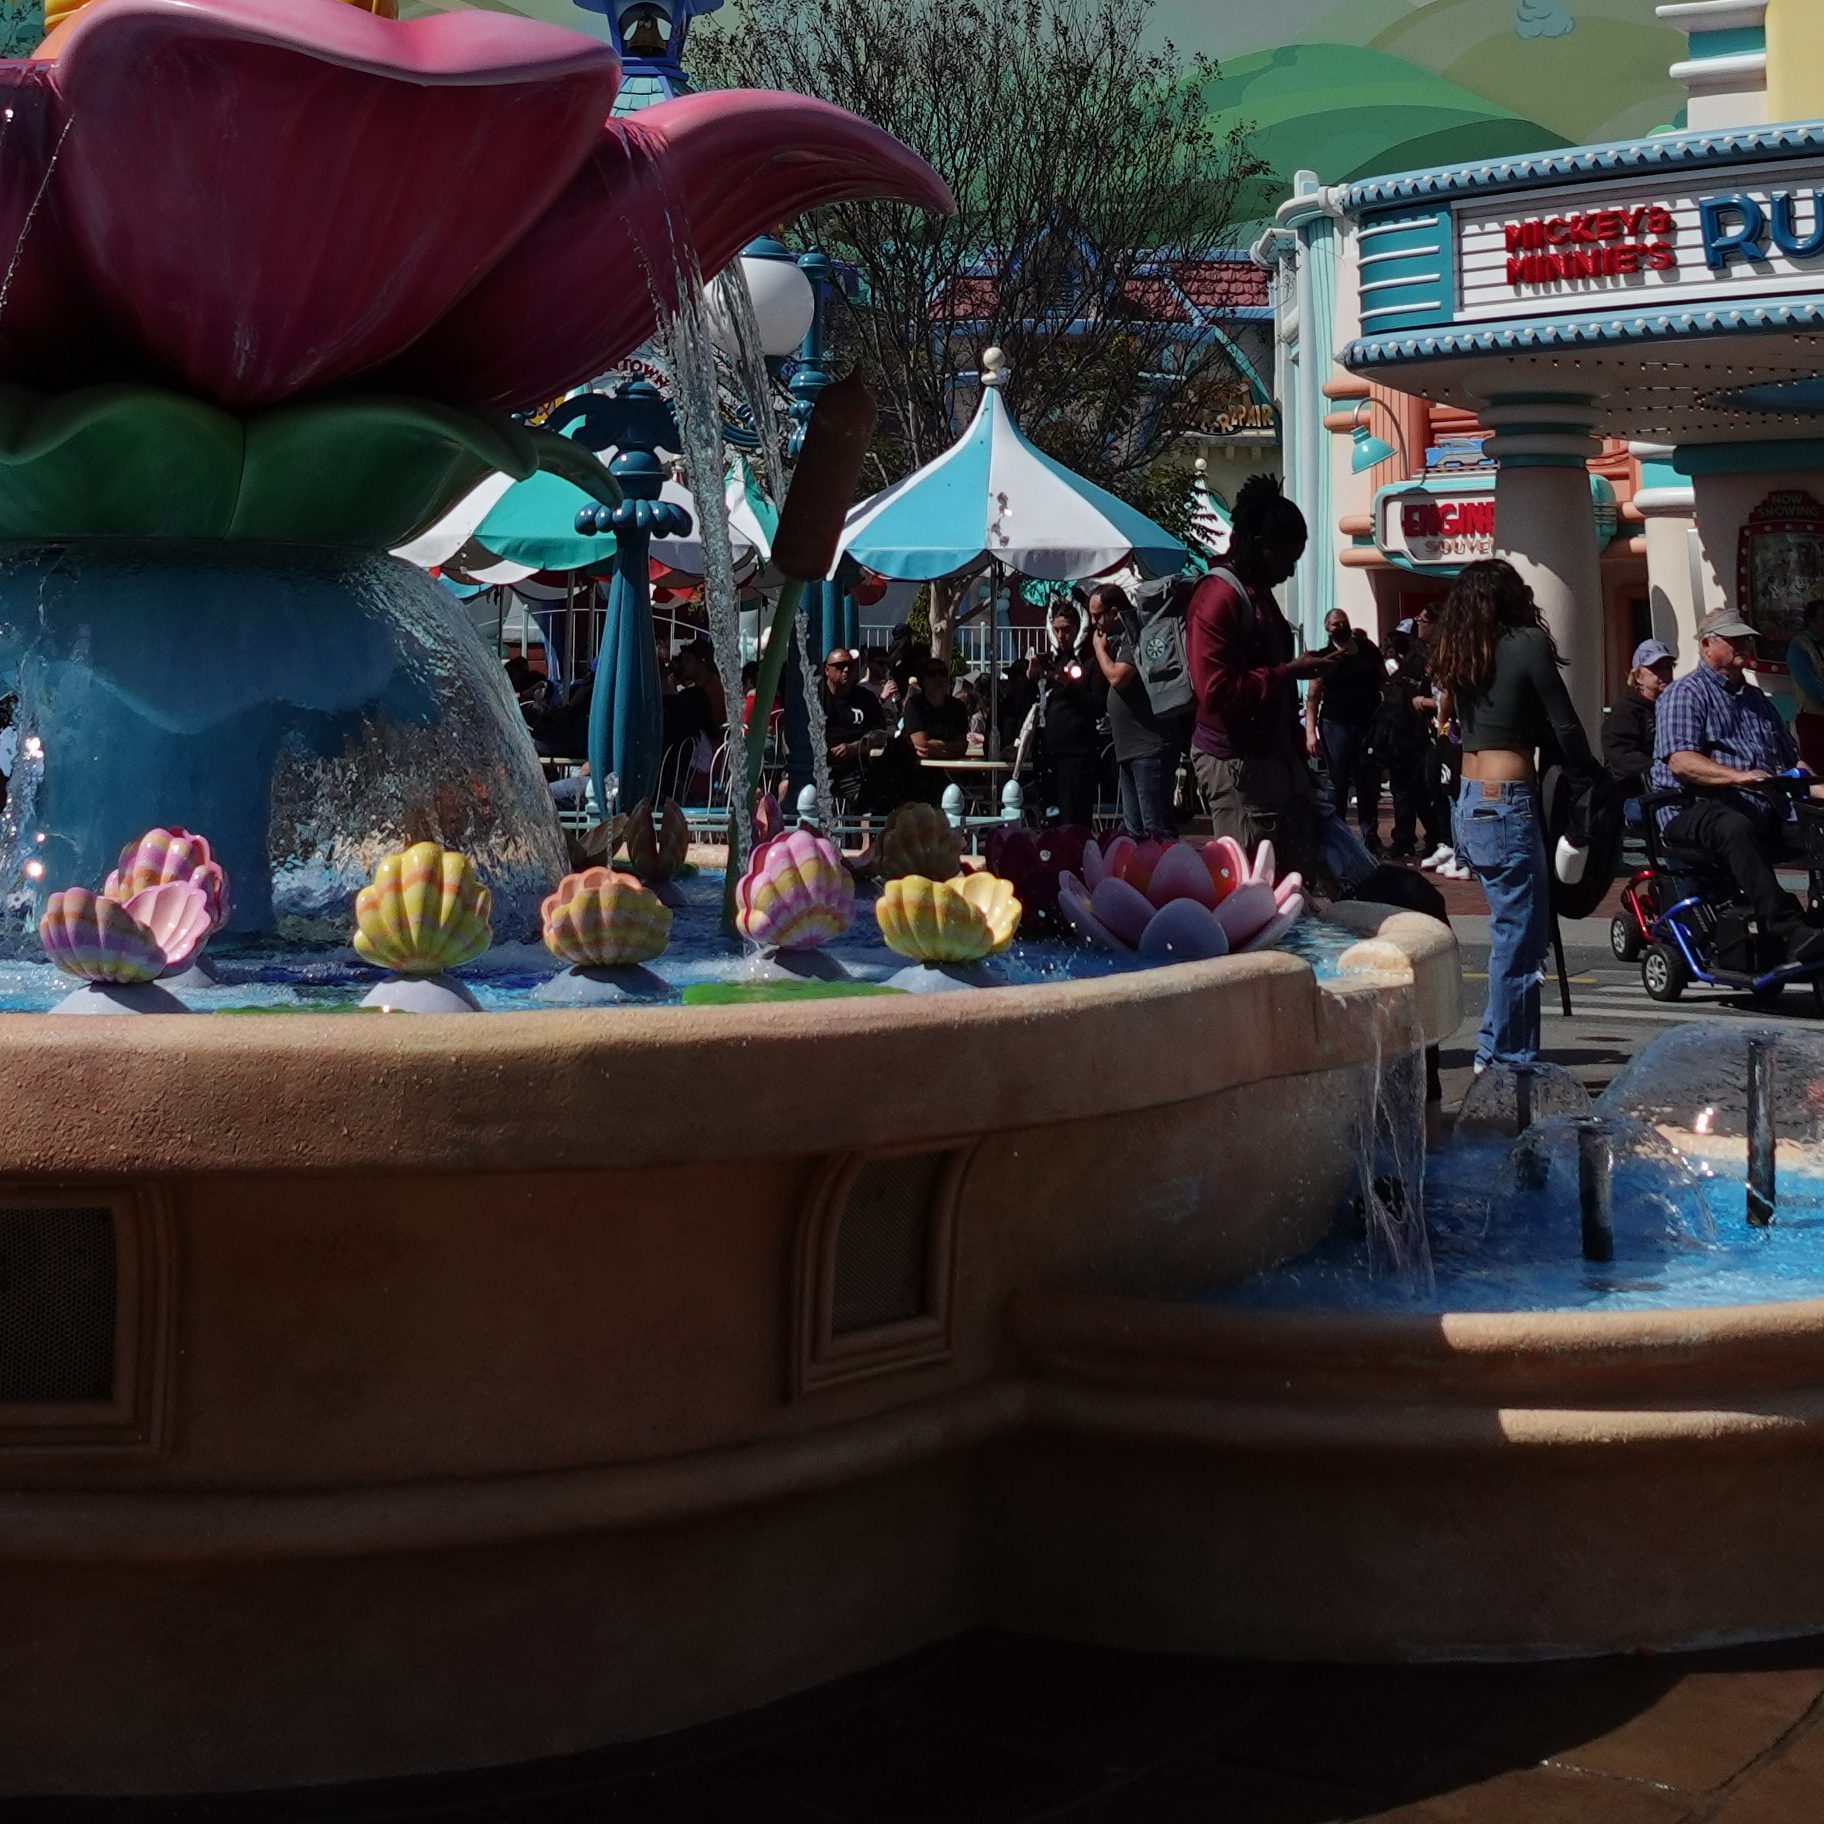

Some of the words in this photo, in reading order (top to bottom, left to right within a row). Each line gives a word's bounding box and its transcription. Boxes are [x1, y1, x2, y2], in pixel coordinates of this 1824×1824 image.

[1506, 240, 1675, 285] MINNIE'S
[1771, 493, 1803, 505] NOW
[1759, 504, 1819, 518] SHOWING
[1425, 538, 1495, 555] SOUVE
